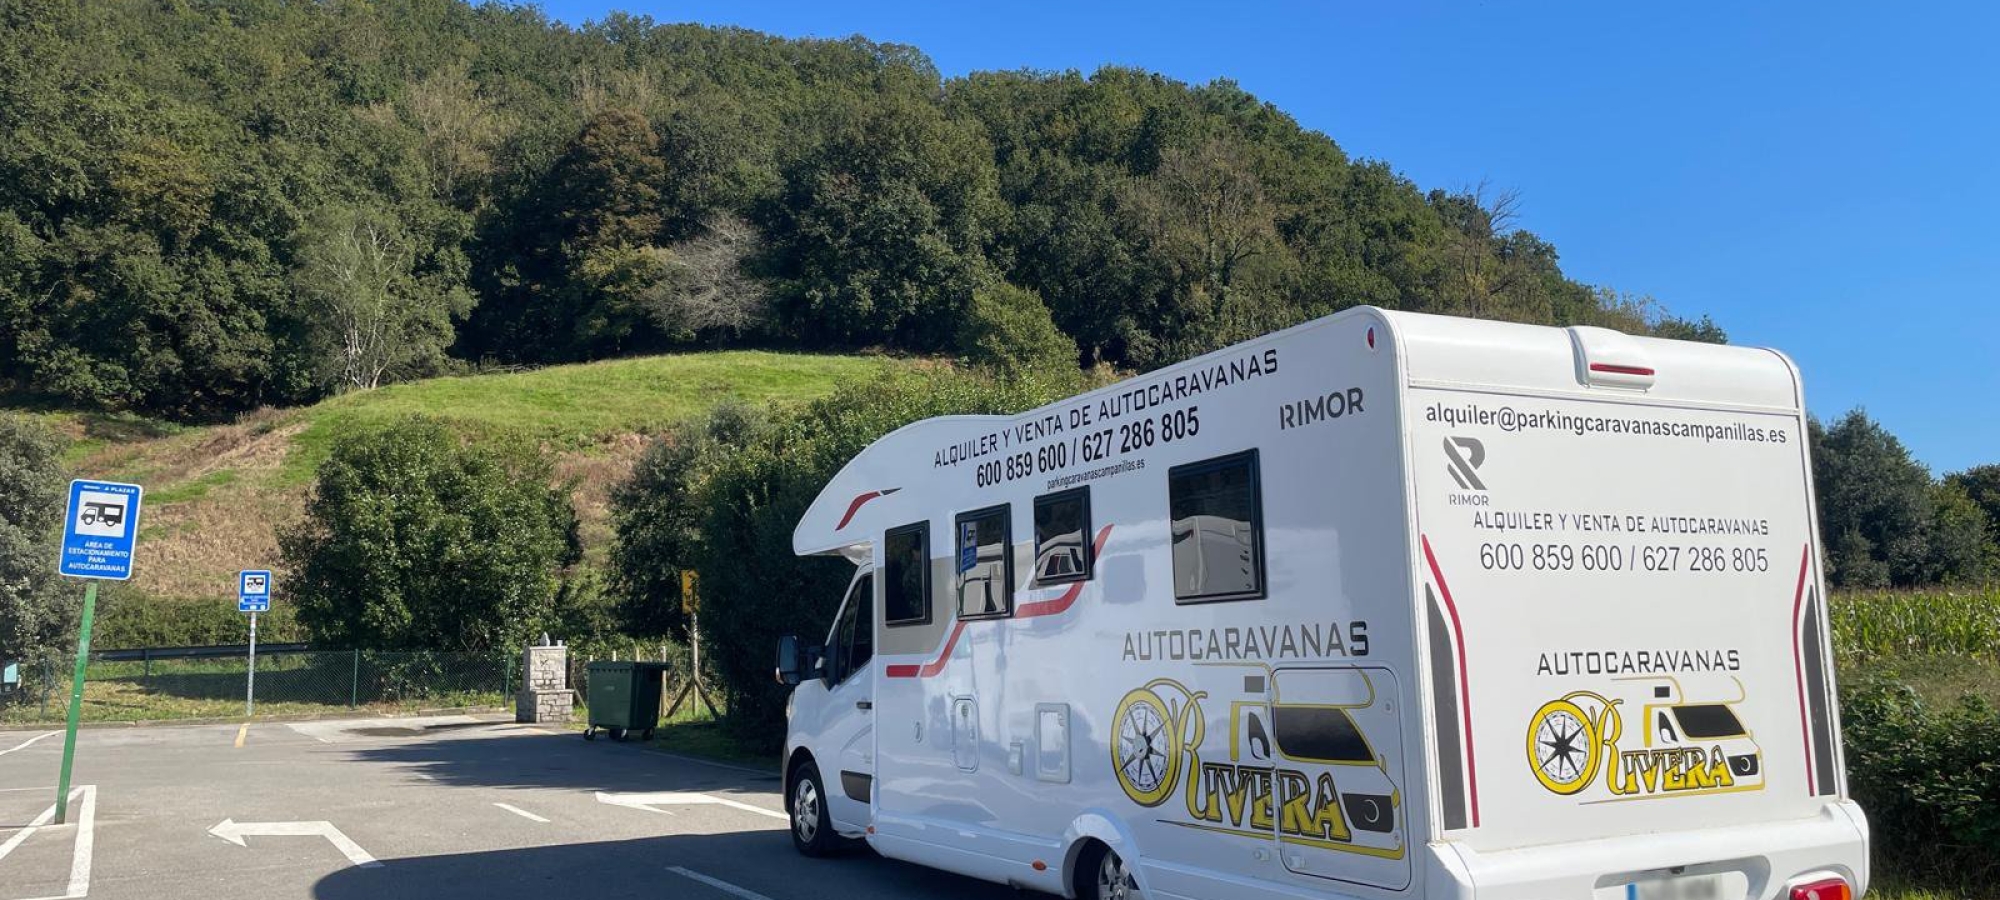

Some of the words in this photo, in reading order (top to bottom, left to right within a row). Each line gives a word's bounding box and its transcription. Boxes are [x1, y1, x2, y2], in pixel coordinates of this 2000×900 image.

[934, 433, 998, 468] ALQUILER
[1002, 429, 1010, 448] Y
[1015, 414, 1063, 443] VENTA
[1070, 404, 1091, 429] DE
[1098, 348, 1278, 421] AUTOCARAVANAS
[1280, 387, 1364, 431] RIMOR
[1426, 403, 1787, 443] alquiler@parkingcaravanascampanillas.es
[977, 459, 1002, 488] 600
[1006, 450, 1033, 481] 859
[1038, 441, 1066, 473] 600
[1072, 437, 1077, 465] /
[1082, 428, 1113, 462] 627
[1120, 418, 1155, 454] 286
[1161, 406, 1200, 443] 805
[1047, 459, 1145, 491] parkingcaravanascampanillas.es
[1449, 493, 1489, 506] RIMOR
[1473, 511, 1553, 532] ALQUILER
[1558, 514, 1568, 529] Y
[1573, 514, 1620, 532] VENTA
[1626, 516, 1645, 532] DE
[1651, 516, 1769, 536] AUTOCARAVANAS
[68, 547, 129, 558] ESTACIONAMIENTO
[104, 542, 113, 550] DE
[1480, 543, 1523, 570] 600
[1533, 544, 1573, 570] 859
[1582, 545, 1622, 570] 600
[1630, 545, 1635, 571] /
[1643, 546, 1680, 571] 627
[1689, 547, 1725, 572] 286
[1732, 547, 1768, 572] 805
[68, 562, 126, 572] AUTOCARAVANAS
[1123, 621, 1370, 662] AUTOCARAVANAS
[1536, 650, 1740, 675] AUTOCARAVANAS
